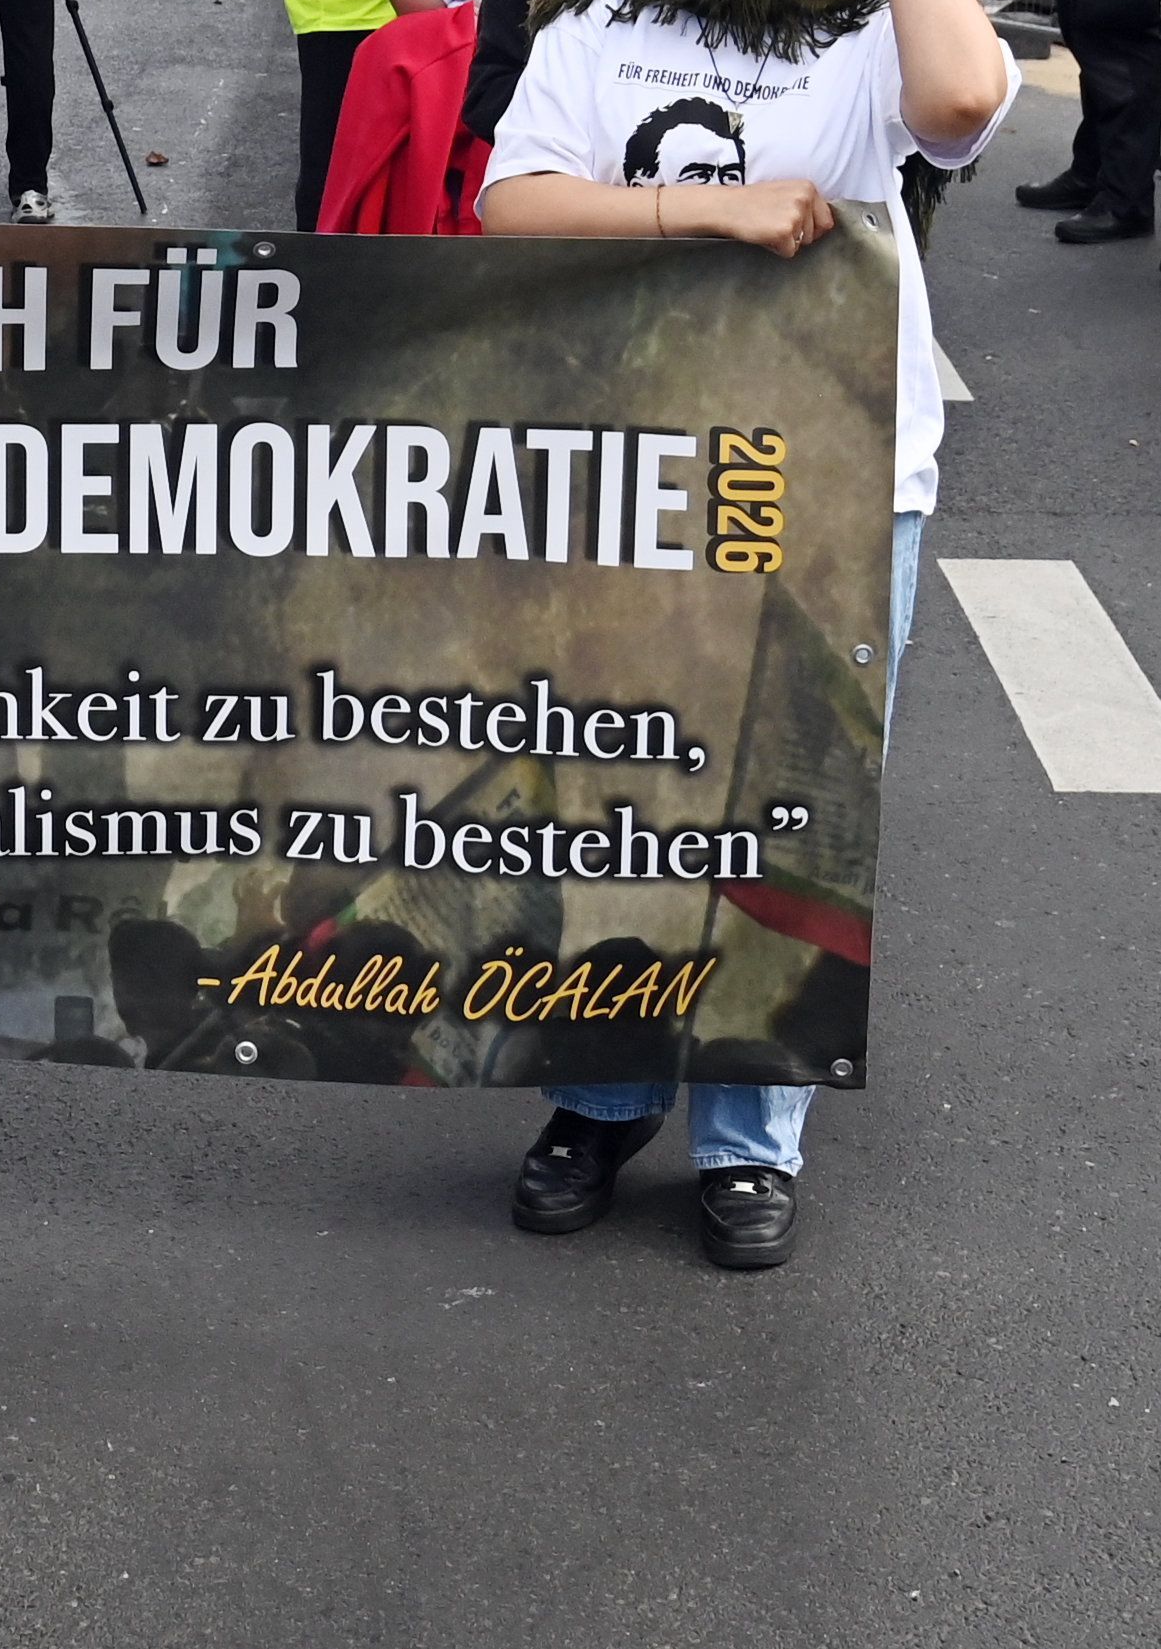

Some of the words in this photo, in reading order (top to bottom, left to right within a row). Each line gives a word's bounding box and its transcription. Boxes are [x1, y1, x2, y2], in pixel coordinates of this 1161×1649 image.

[618, 60, 642, 80] FÜR
[645, 68, 701, 88] FREIHEIT
[703, 73, 732, 93] UND
[89, 247, 301, 370] FÜR
[716, 431, 786, 573] 2026
[203, 692, 295, 741] zu
[316, 670, 707, 770] bestehen,
[286, 816, 380, 866] zu
[401, 792, 809, 880] bestehen”
[463, 946, 717, 1024] ÖCALAN
